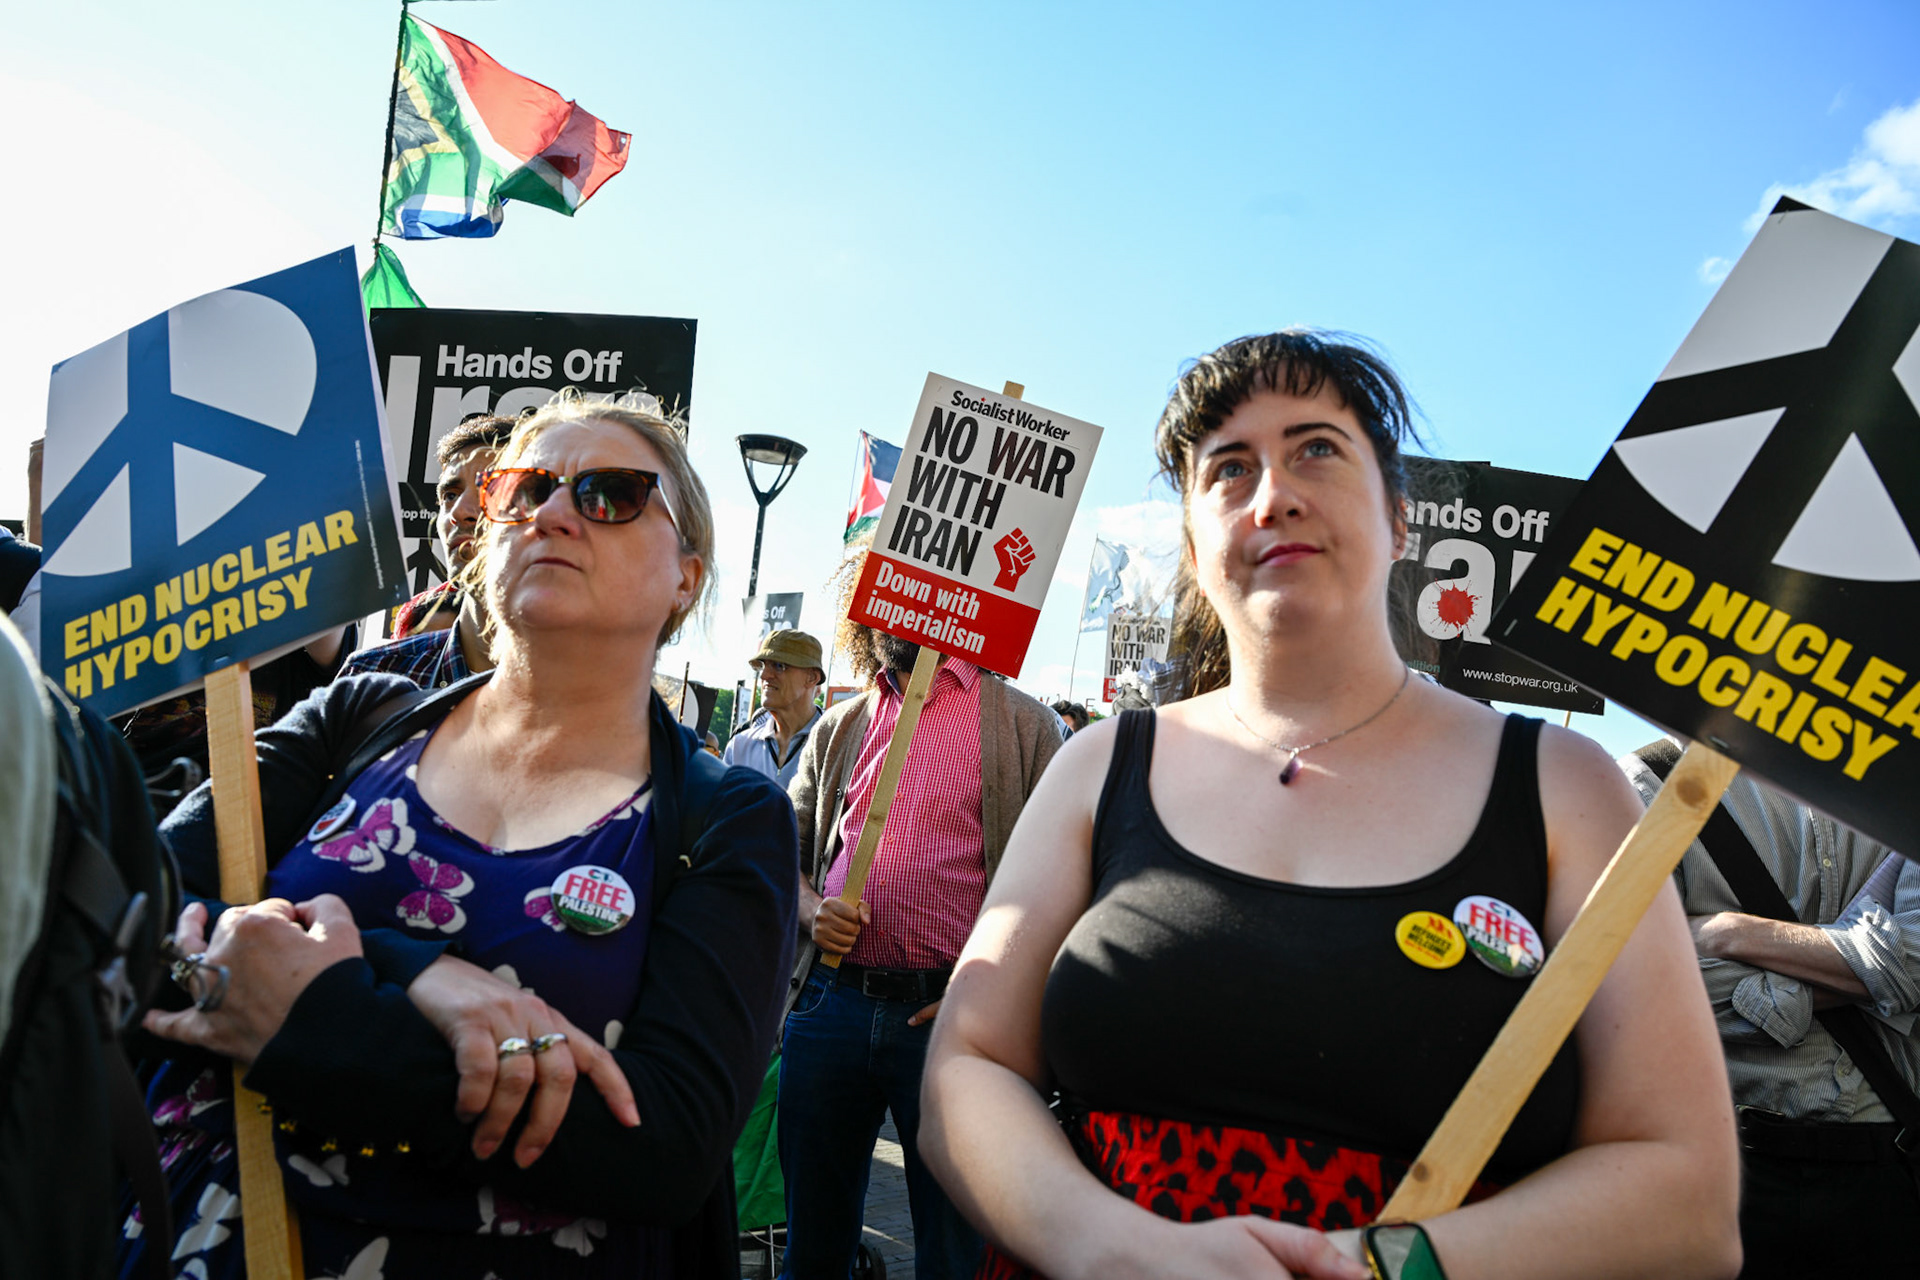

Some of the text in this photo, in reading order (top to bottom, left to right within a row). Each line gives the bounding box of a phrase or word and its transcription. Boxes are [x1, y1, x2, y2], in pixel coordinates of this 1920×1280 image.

[437, 344, 623, 383] Hands Off
[920, 406, 1076, 499] NO WAR
[401, 508, 418, 521] top
[907, 454, 1007, 529] WITH
[888, 505, 983, 577] IRAN
[1404, 497, 1549, 543] ands Off
[65, 594, 147, 660] END
[155, 509, 359, 621] NUCLEAR
[875, 561, 980, 621] Down with
[1568, 527, 1697, 612] END
[65, 567, 313, 699] HYPOCRISY
[770, 606, 786, 619] Off
[865, 590, 985, 655] imperialism
[1112, 624, 1166, 644] NO WAR
[1111, 642, 1145, 660] WITH
[1463, 668, 1578, 693] www.stopwar.org.uk
[1535, 576, 1900, 781] HYPOCRISY
[558, 895, 620, 924] PALESTINE
[563, 873, 627, 912] FREE
[1469, 903, 1533, 955] FREE
